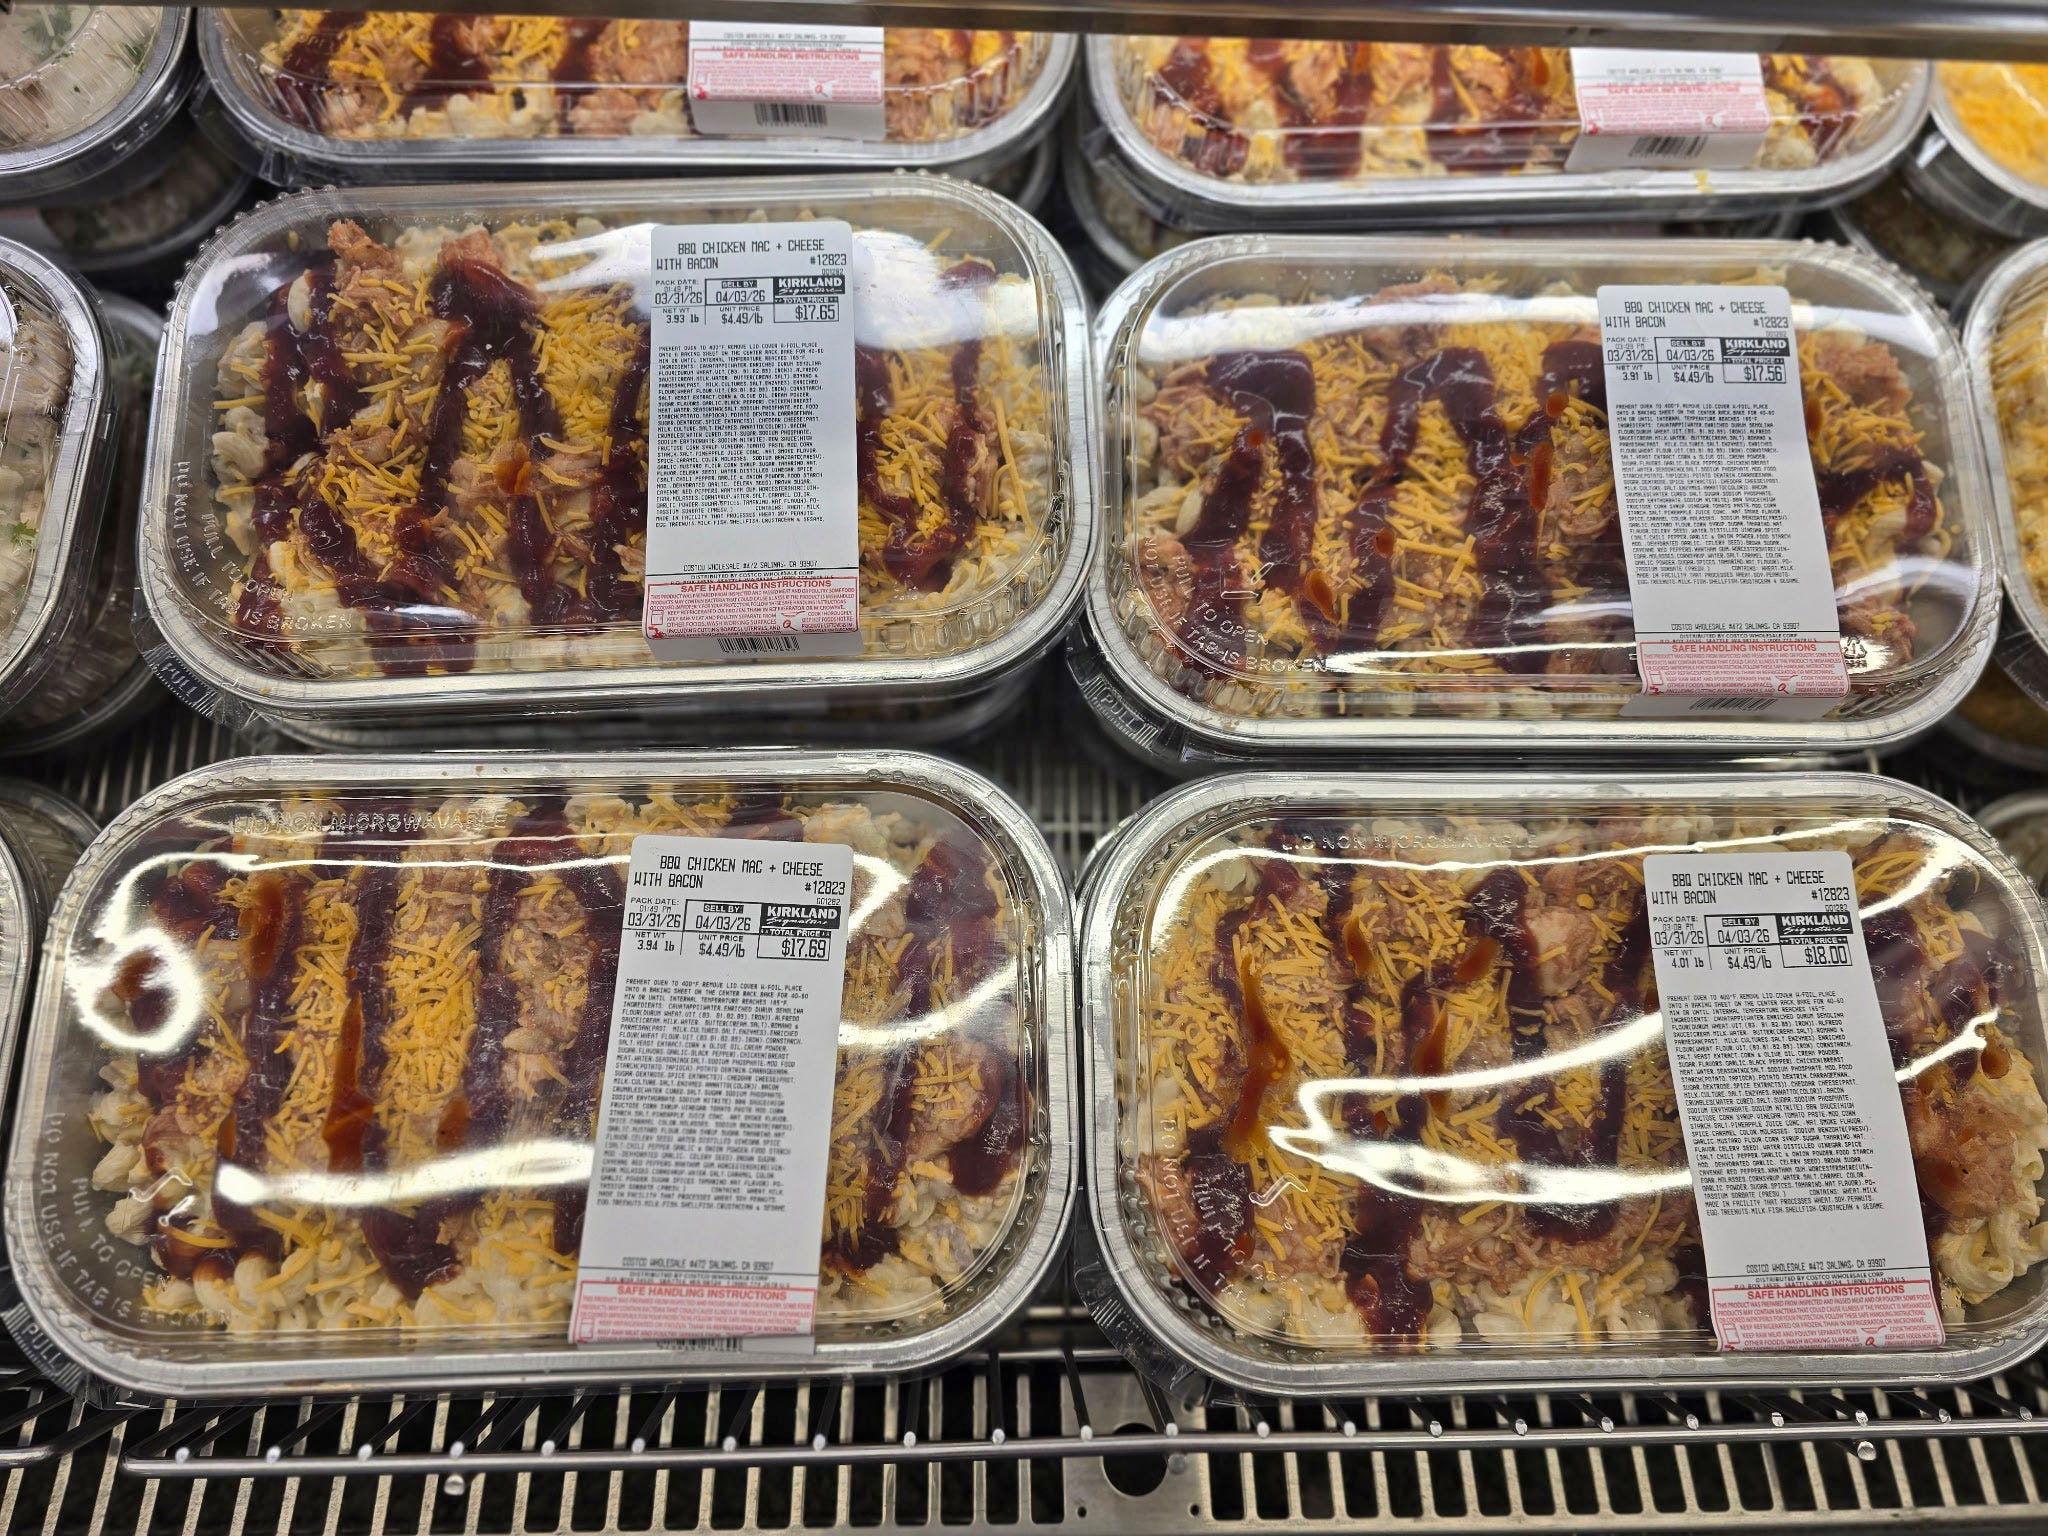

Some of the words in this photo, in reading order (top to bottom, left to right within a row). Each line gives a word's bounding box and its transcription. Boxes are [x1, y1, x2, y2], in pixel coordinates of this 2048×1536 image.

[723, 52, 745, 60] SAFE
[748, 52, 793, 60] HANDLING
[795, 53, 860, 61] INSTRUCTIONS
[678, 243, 697, 254] BBQ
[703, 241, 746, 253] CHICKEN
[752, 241, 770, 252] MAC
[777, 243, 781, 251] +
[788, 239, 824, 251] CHEESE
[657, 258, 681, 270] WITH
[687, 257, 718, 269] BACON
[810, 254, 847, 266] #12823
[779, 278, 842, 287] KIRKLAND
[655, 293, 702, 304] 03/31/26
[716, 290, 765, 302] 04/03/26
[795, 305, 836, 320] $17.65
[1625, 302, 1642, 313] BBQ
[1649, 302, 1690, 313] CHICKEN
[1696, 302, 1713, 313] MAC
[1731, 302, 1766, 313] CHEESE
[666, 315, 685, 323] 3.93
[690, 314, 699, 323] lb
[722, 314, 762, 324] $4.49/lb
[1606, 317, 1630, 327] WITH
[1636, 317, 1665, 327] BACON
[1754, 317, 1788, 328] #12823
[1725, 339, 1786, 348] KIRKLAND
[1608, 350, 1654, 361] 03/31/26
[1667, 350, 1714, 361] 04/03/26
[1623, 372, 1638, 381] 3.91
[1644, 372, 1652, 380] lb
[1674, 371, 1713, 383] $4.49/lb
[1745, 366, 1782, 381] $17.56
[709, 583, 758, 591] HANDLING
[761, 580, 831, 589] INSTRUCTIONS
[1193, 604, 1217, 622] TO
[1220, 620, 1269, 645] OPEN
[1672, 644, 1696, 652] SAFE
[1699, 644, 1747, 652] HANDLING
[1246, 656, 1327, 673] BROKEN
[277, 812, 323, 833] NON
[660, 856, 680, 869] BBQ
[688, 857, 735, 872] CHICKEN
[742, 860, 762, 873] MAC
[783, 862, 823, 876] CHEESE
[634, 873, 662, 887] WITH
[669, 874, 703, 888] BACON
[1672, 874, 1691, 886] BBQ
[1698, 872, 1743, 886] CHICKEN
[1749, 872, 1768, 885] MAC
[1775, 875, 1781, 883] +
[1787, 871, 1825, 884] CHEESE
[805, 881, 845, 895] #12823
[1812, 887, 1850, 900] #12823
[1652, 891, 1678, 904] WITH
[1684, 891, 1716, 903] BACON
[767, 906, 837, 918] KIRKLAND
[628, 913, 681, 928] 03/31/26
[696, 916, 751, 930] 04/03/26
[766, 917, 828, 926] Signature
[1782, 915, 1848, 926] KIRKLAND
[1718, 929, 1769, 943] 04/03/26
[1783, 926, 1850, 934] Signature
[1655, 931, 1704, 945] 03/31/26
[637, 940, 657, 950] 3.94
[665, 941, 674, 951] lb
[699, 944, 745, 957] $4.49/lb
[782, 939, 826, 958] $17.69
[1805, 946, 1847, 964] $18.00
[1672, 958, 1689, 968] 4.01
[1695, 957, 1704, 968] lb
[1728, 955, 1772, 969] $4.49/lb
[90, 1234, 115, 1262] TO
[41, 1204, 65, 1247] USE
[56, 1249, 77, 1271] IF
[111, 1297, 131, 1318] IS
[1747, 1264, 1769, 1273] COSTCO
[1772, 1262, 1805, 1272] WHOLESALE
[1857, 1259, 1865, 1268] CA
[617, 1286, 645, 1295] SAFE
[648, 1287, 704, 1297] HANDLING
[707, 1289, 787, 1300] INSTRUCTIONS
[1748, 1291, 1774, 1299] SAFE
[1777, 1288, 1829, 1298] HANDLING
[1832, 1285, 1905, 1296] INSTRUCTIONS
[23, 1324, 62, 1368] PULL
